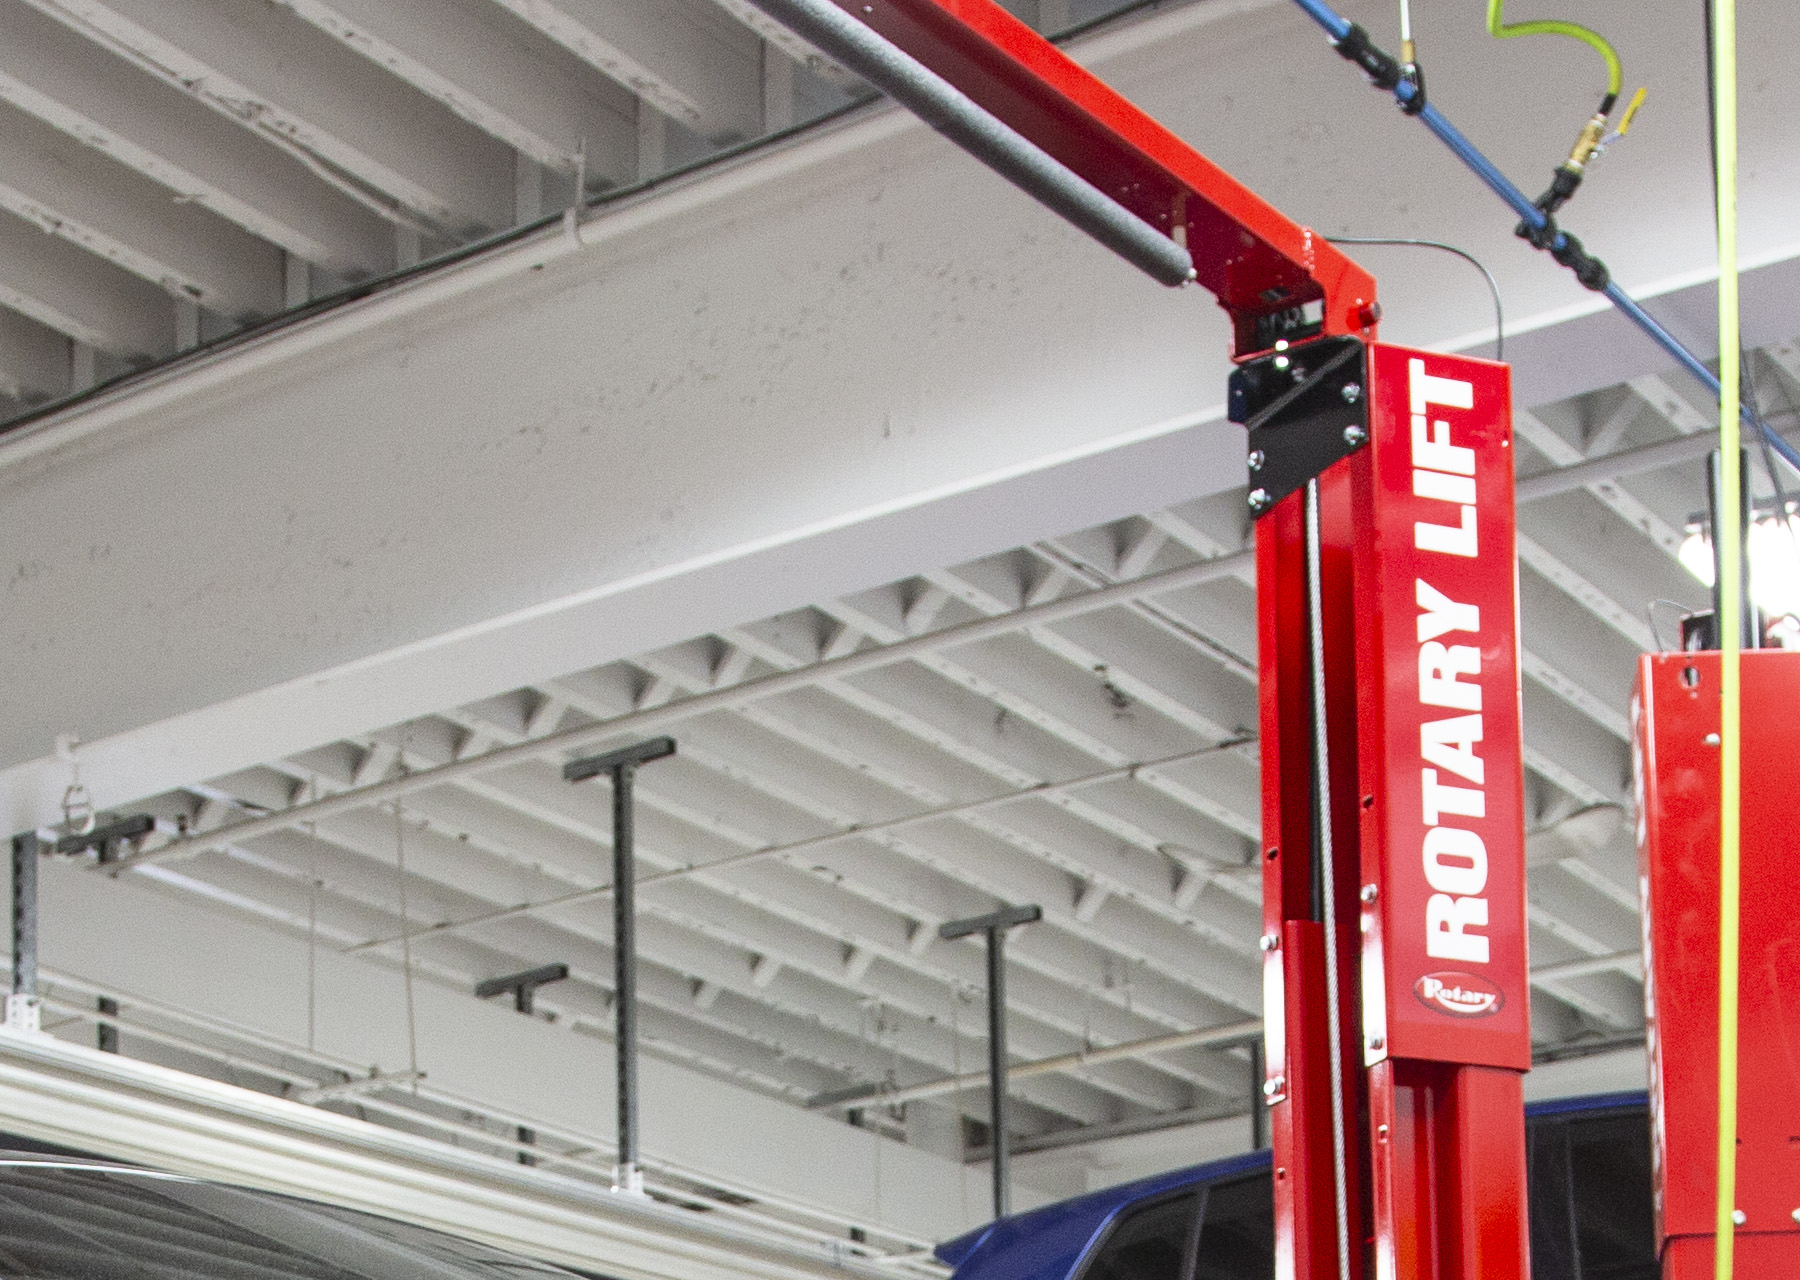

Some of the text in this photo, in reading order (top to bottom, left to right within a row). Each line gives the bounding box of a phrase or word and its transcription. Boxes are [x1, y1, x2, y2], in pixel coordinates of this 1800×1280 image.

[1409, 358, 1491, 965] ROTARY LIFT
[1423, 974, 1496, 1011] Rotary
